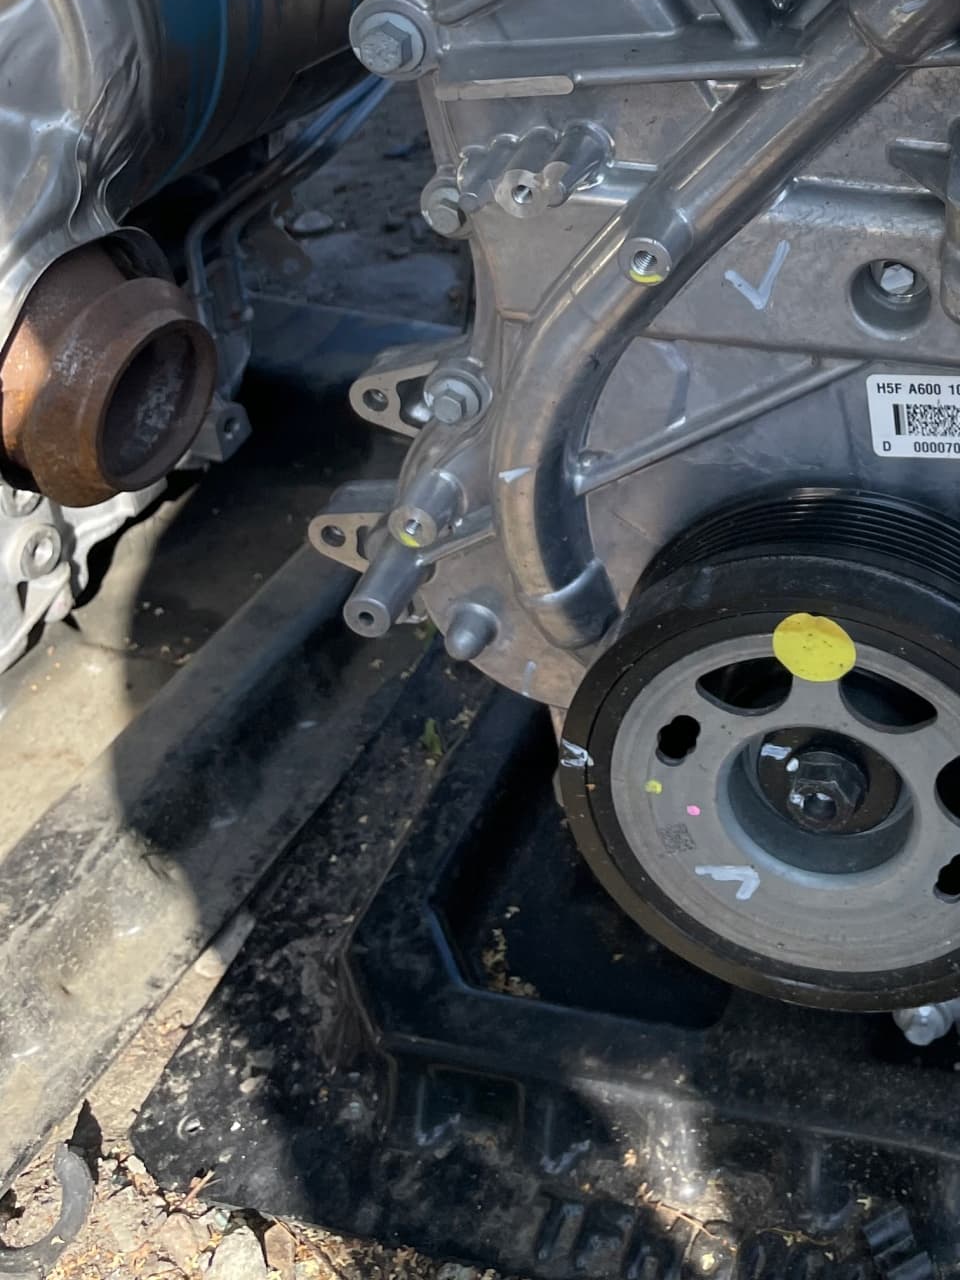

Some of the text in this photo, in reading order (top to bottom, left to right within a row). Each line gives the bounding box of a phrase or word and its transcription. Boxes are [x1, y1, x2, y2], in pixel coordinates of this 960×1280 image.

[876, 382, 902, 394] H5F
[908, 383, 941, 395] A600
[882, 440, 960, 454] D 000070
